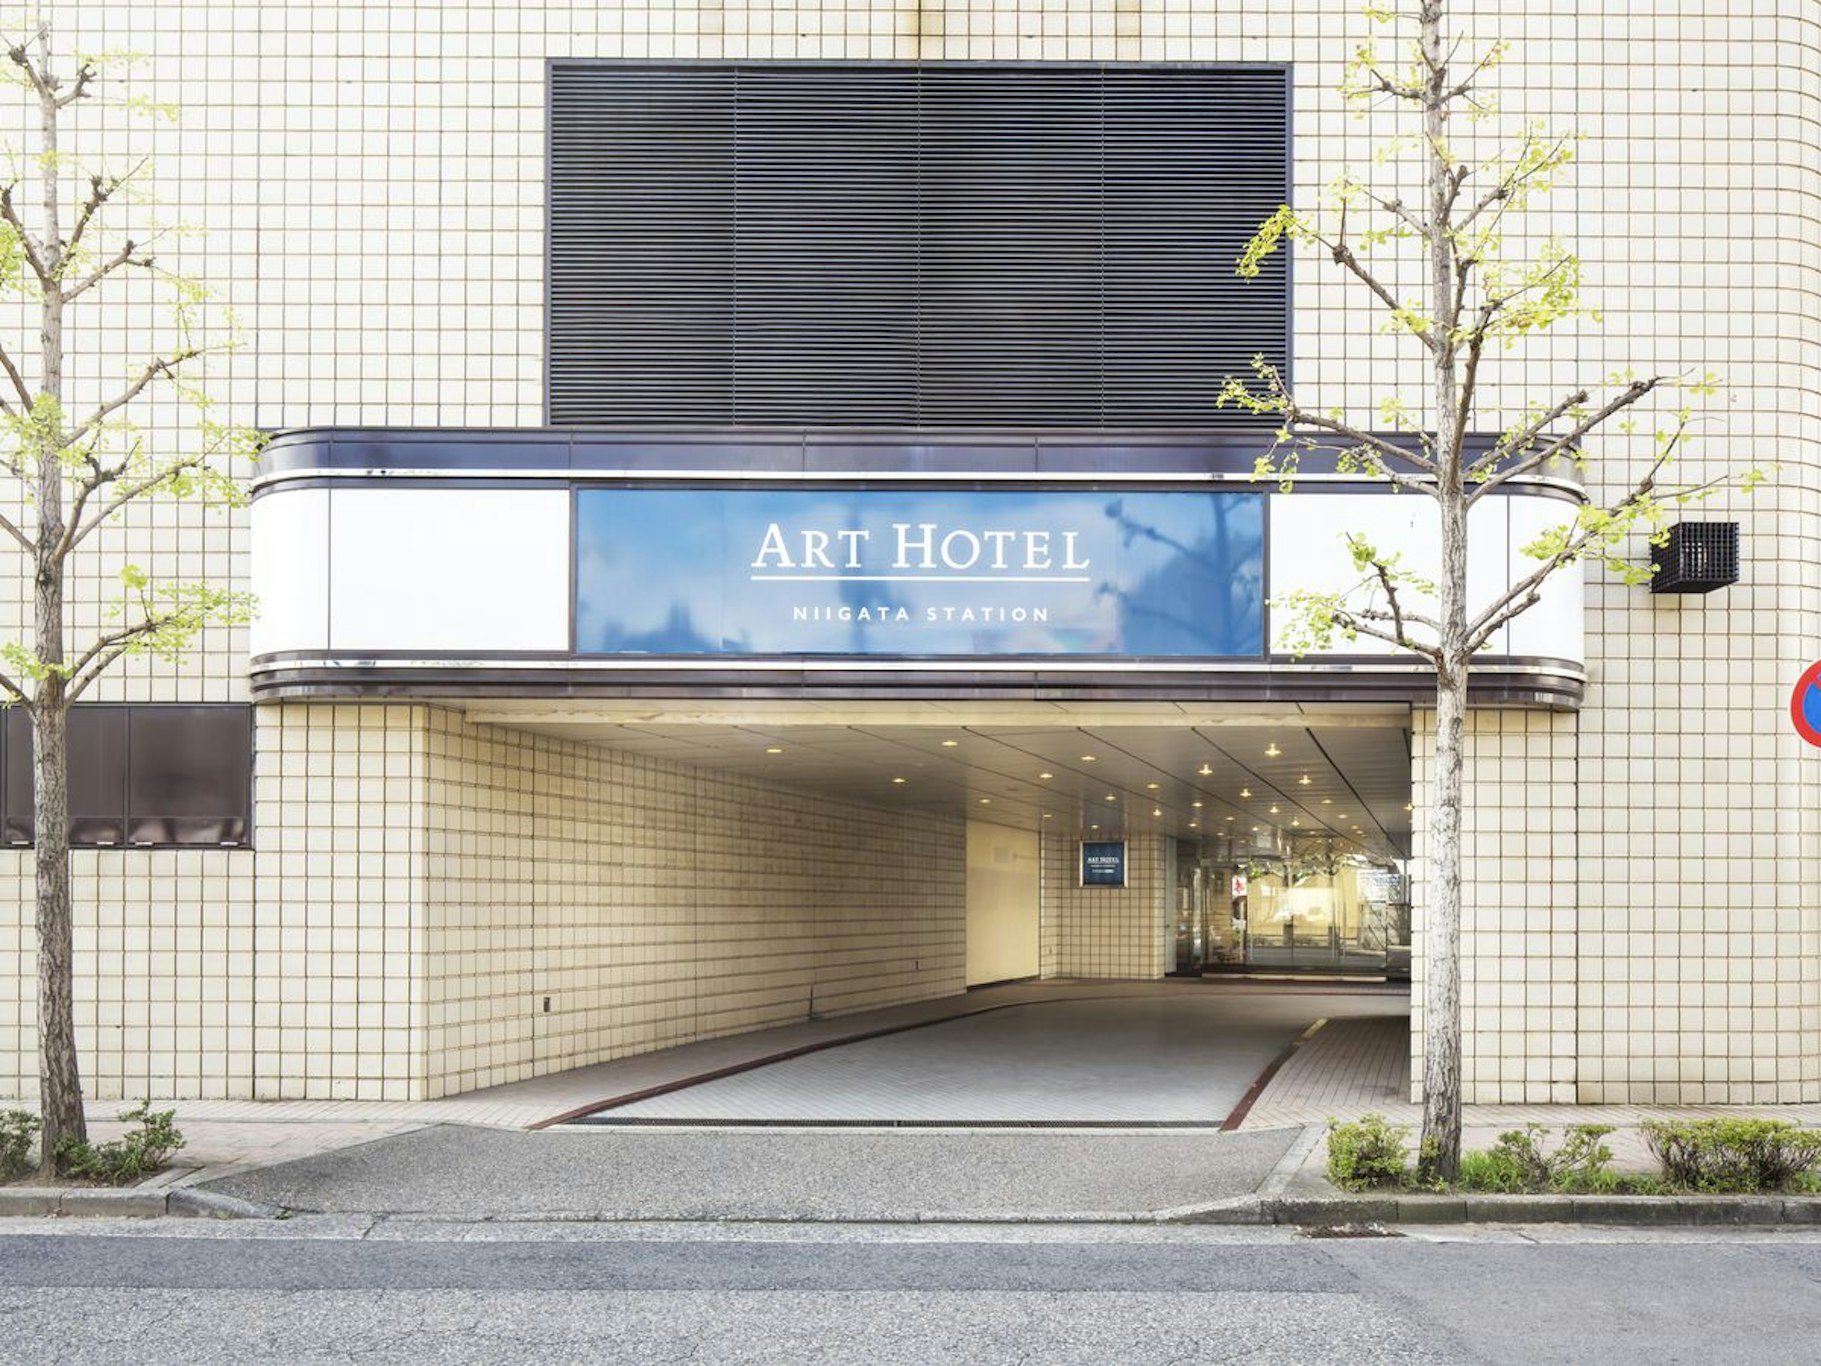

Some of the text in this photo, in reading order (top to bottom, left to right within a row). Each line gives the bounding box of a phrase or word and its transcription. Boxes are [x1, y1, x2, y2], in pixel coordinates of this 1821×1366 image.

[751, 523, 1090, 569] ART HOTEL
[792, 606, 1048, 622] NIIGATA STATION
